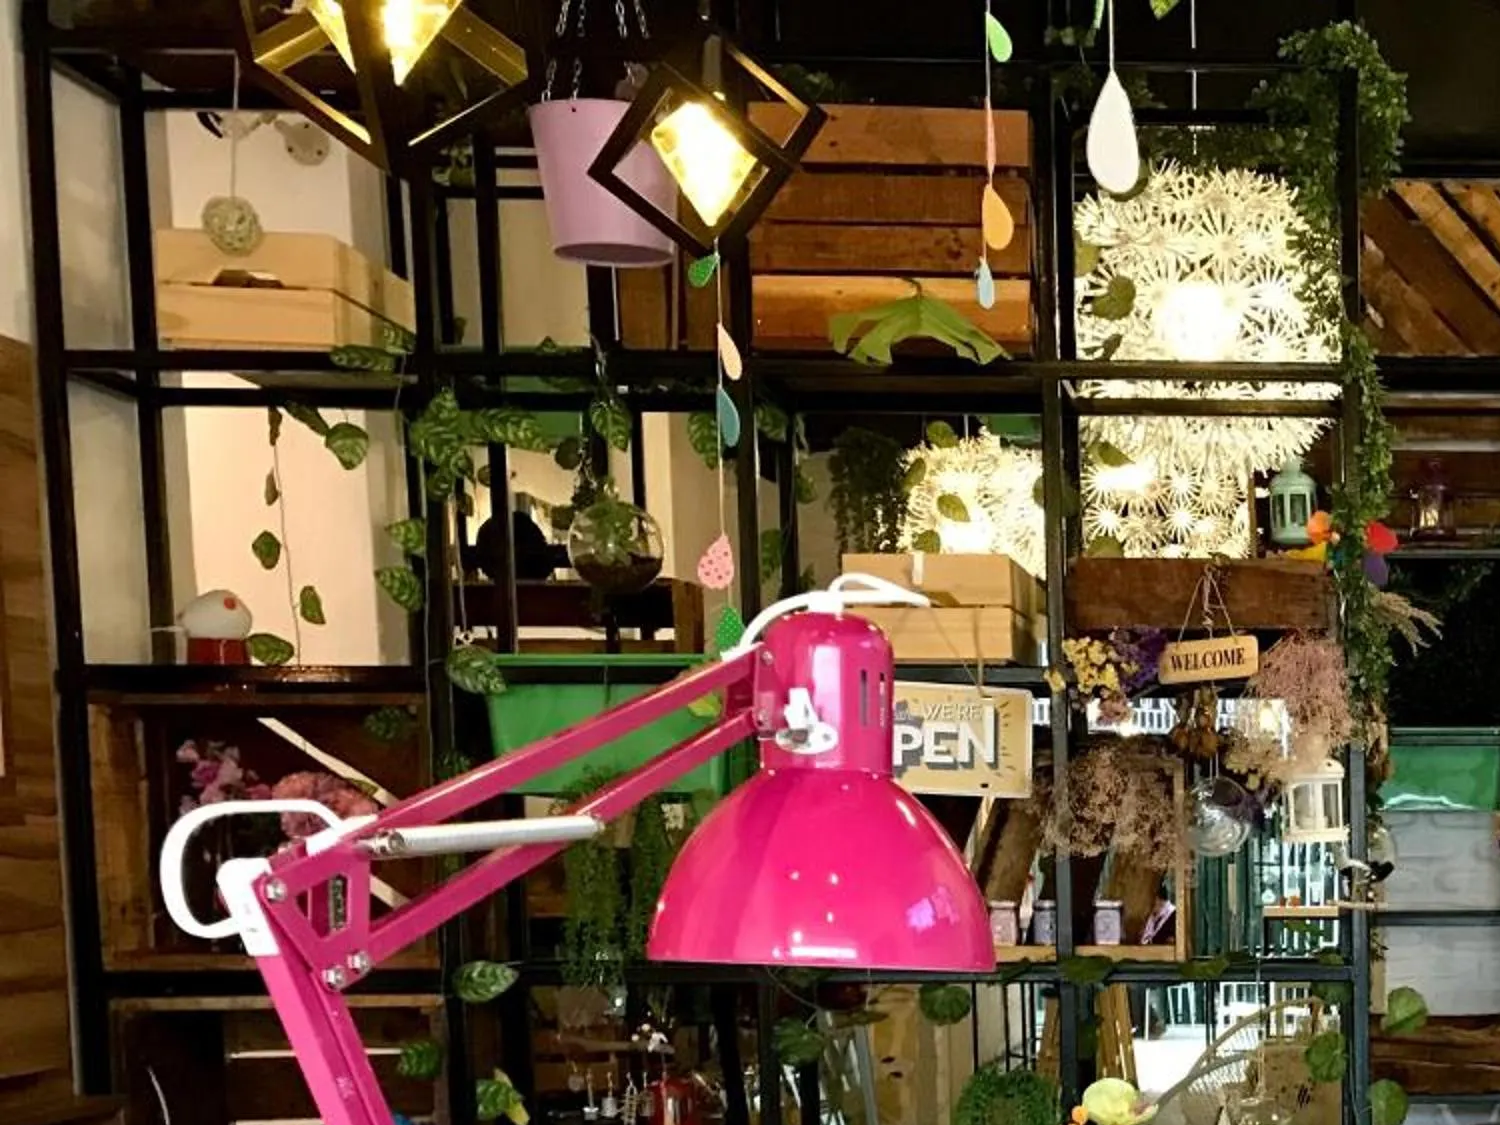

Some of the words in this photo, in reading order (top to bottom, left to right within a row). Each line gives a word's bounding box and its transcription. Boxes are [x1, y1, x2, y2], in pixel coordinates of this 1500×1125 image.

[1171, 647, 1245, 672] WELCOME
[924, 703, 982, 721] WE'RE
[893, 704, 995, 766] PEN
